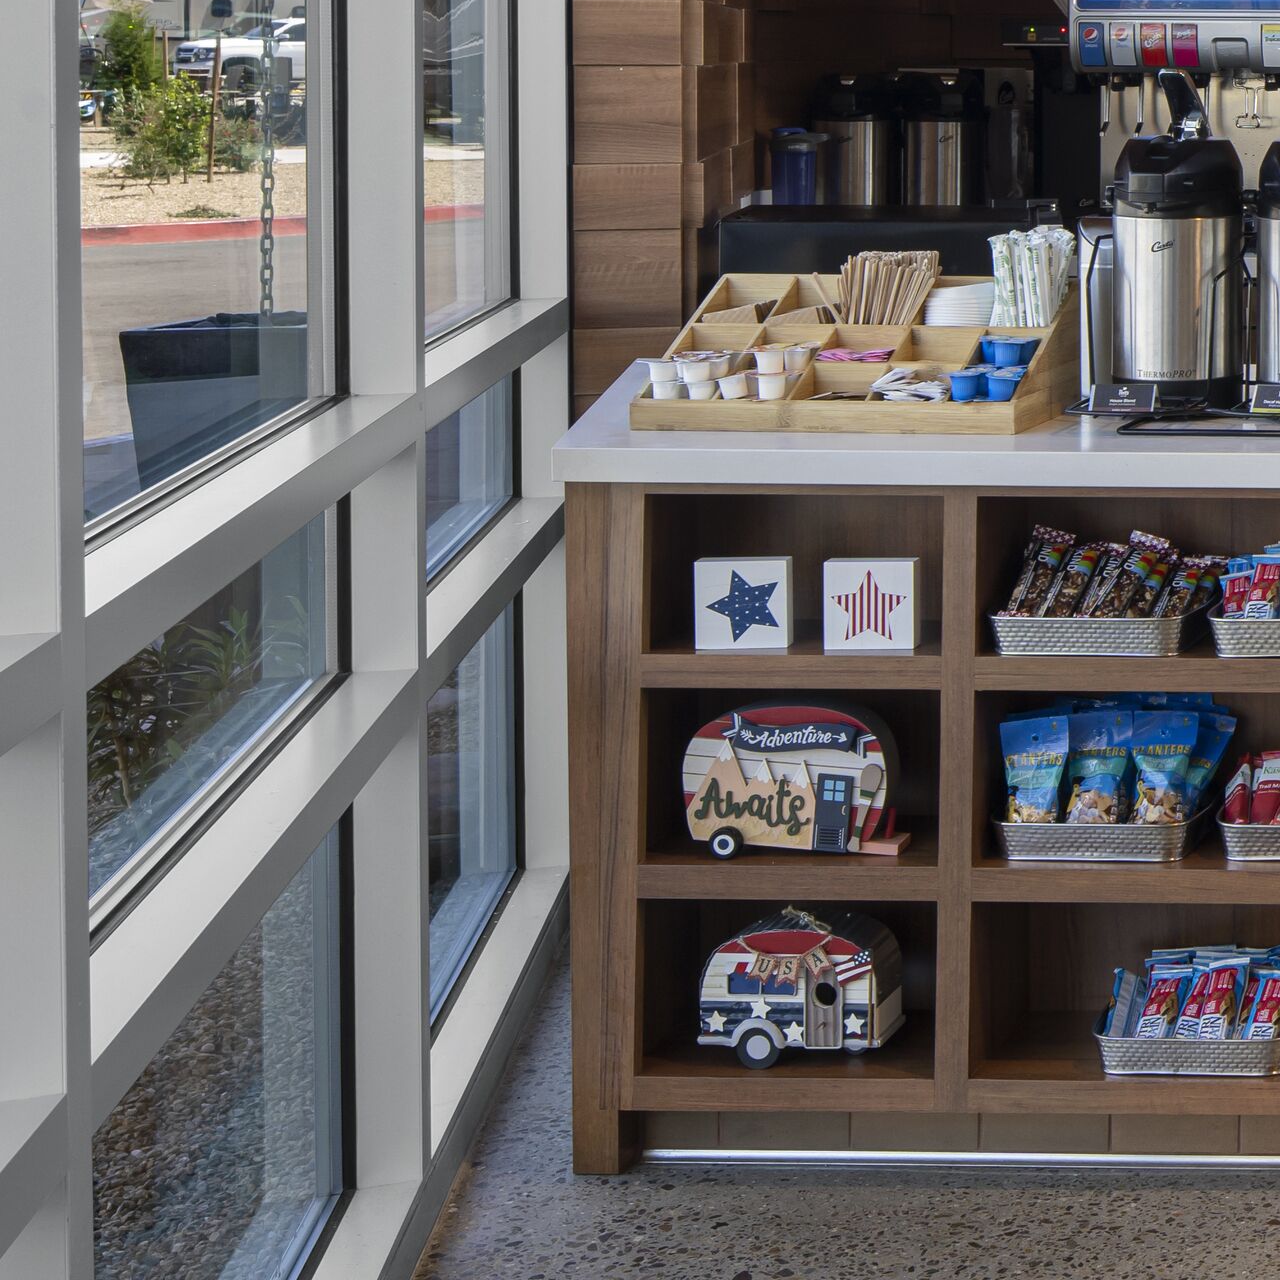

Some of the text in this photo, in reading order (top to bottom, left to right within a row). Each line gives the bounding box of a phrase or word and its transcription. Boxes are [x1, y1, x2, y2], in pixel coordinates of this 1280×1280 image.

[1151, 239, 1176, 253] Curtis
[1067, 548, 1084, 571] KIND
[752, 725, 833, 748] Adventure
[1006, 751, 1063, 768] PLANTERS
[1132, 743, 1191, 756] PLANTERS
[694, 777, 810, 836] Awaits
